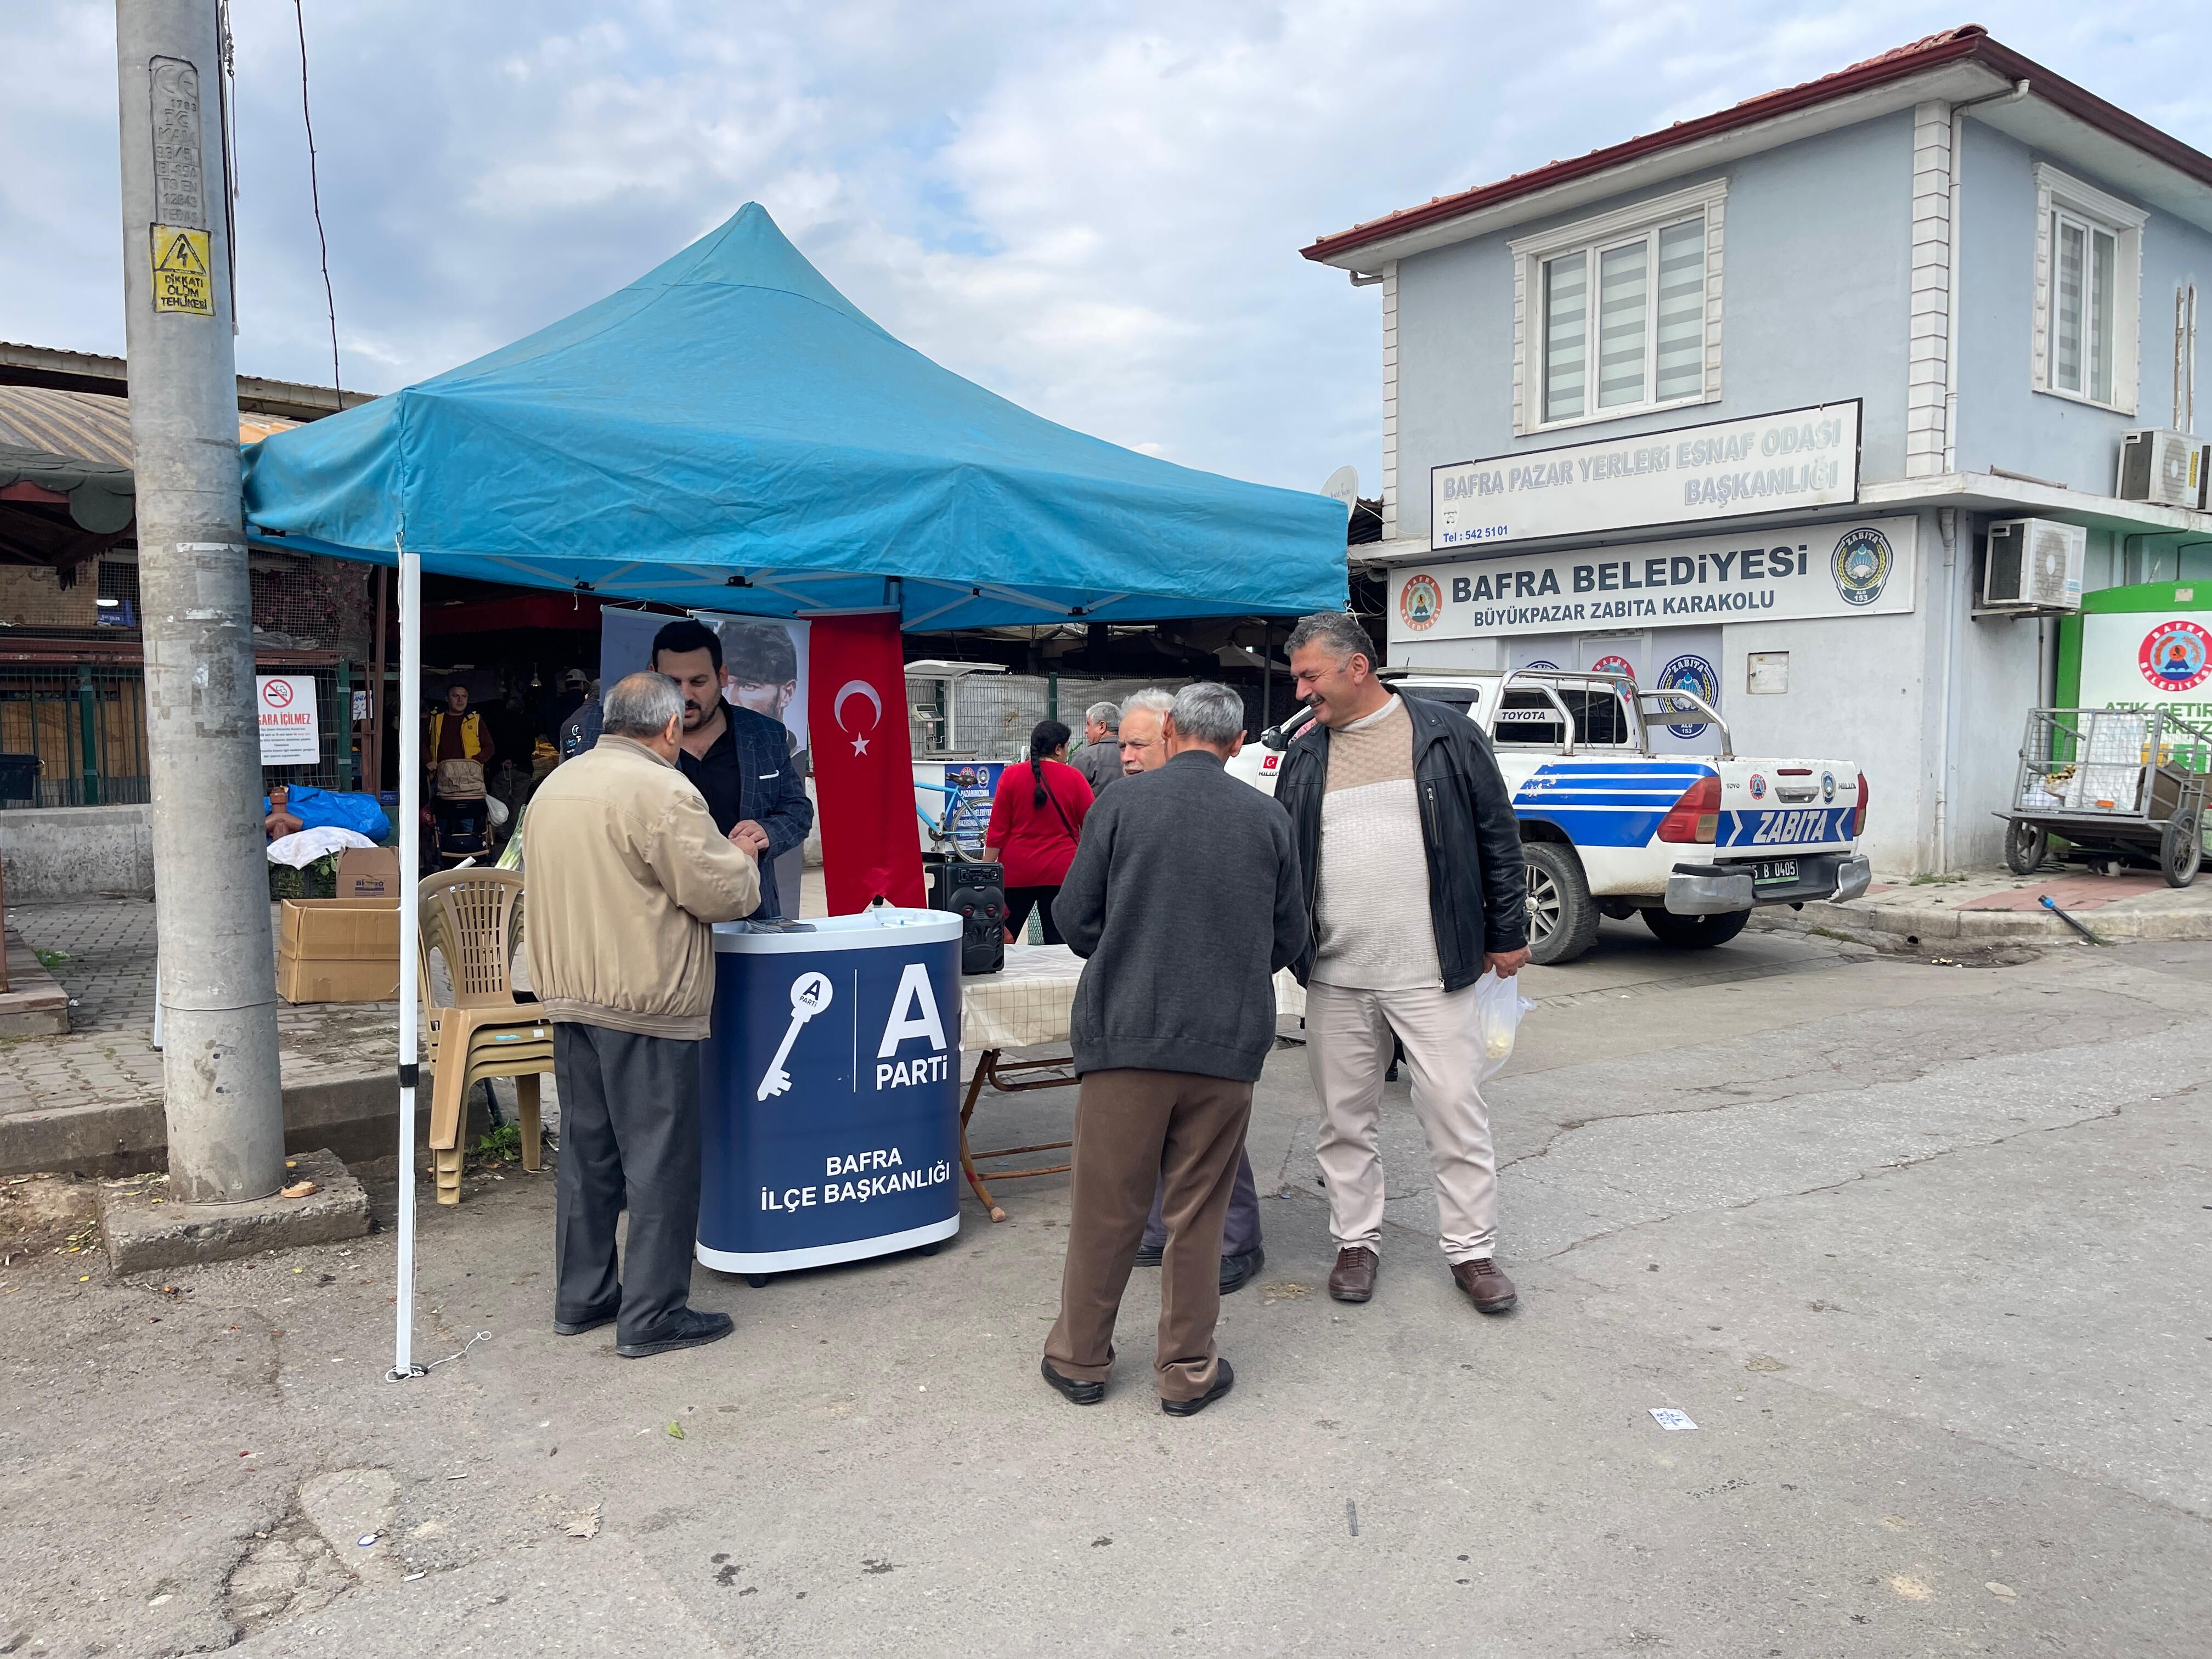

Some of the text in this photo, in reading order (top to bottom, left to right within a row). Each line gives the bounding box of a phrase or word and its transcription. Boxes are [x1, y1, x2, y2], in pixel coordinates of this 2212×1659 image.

[1443, 418, 1842, 501] BAFRA PAZAR YERLERİ ESNAF ODASI
[1684, 455, 1839, 509] BAŞKANLIĞI
[1443, 532, 1457, 543] Tel
[1465, 528, 1482, 540] 542
[1485, 525, 1508, 538] 5101
[1846, 532, 1879, 546] ZABITA
[1407, 576, 1436, 590] BAFRA
[1453, 568, 1561, 603] BAFRA
[1474, 590, 1774, 627] BÜYÜKPAZAR ZABITA KARAKOLU
[2152, 623, 2205, 640] BAFRA
[1595, 657, 1628, 670] BAFRA
[1671, 658, 1703, 673] ZABITA
[280, 712, 311, 726] İÇİLMEZ
[1502, 712, 1545, 720] TOYOTA
[2146, 720, 2212, 735] ERKEZ
[1752, 810, 1829, 844] ZABITA
[1763, 864, 1769, 878] B
[1774, 861, 1795, 877] 0405
[803, 979, 821, 1001] A
[877, 963, 947, 1059] A
[877, 1054, 948, 1090] PARTİ
[826, 1147, 902, 1177] BAFRA
[761, 1160, 950, 1213] İLÇE BAŞKANLIĞI
